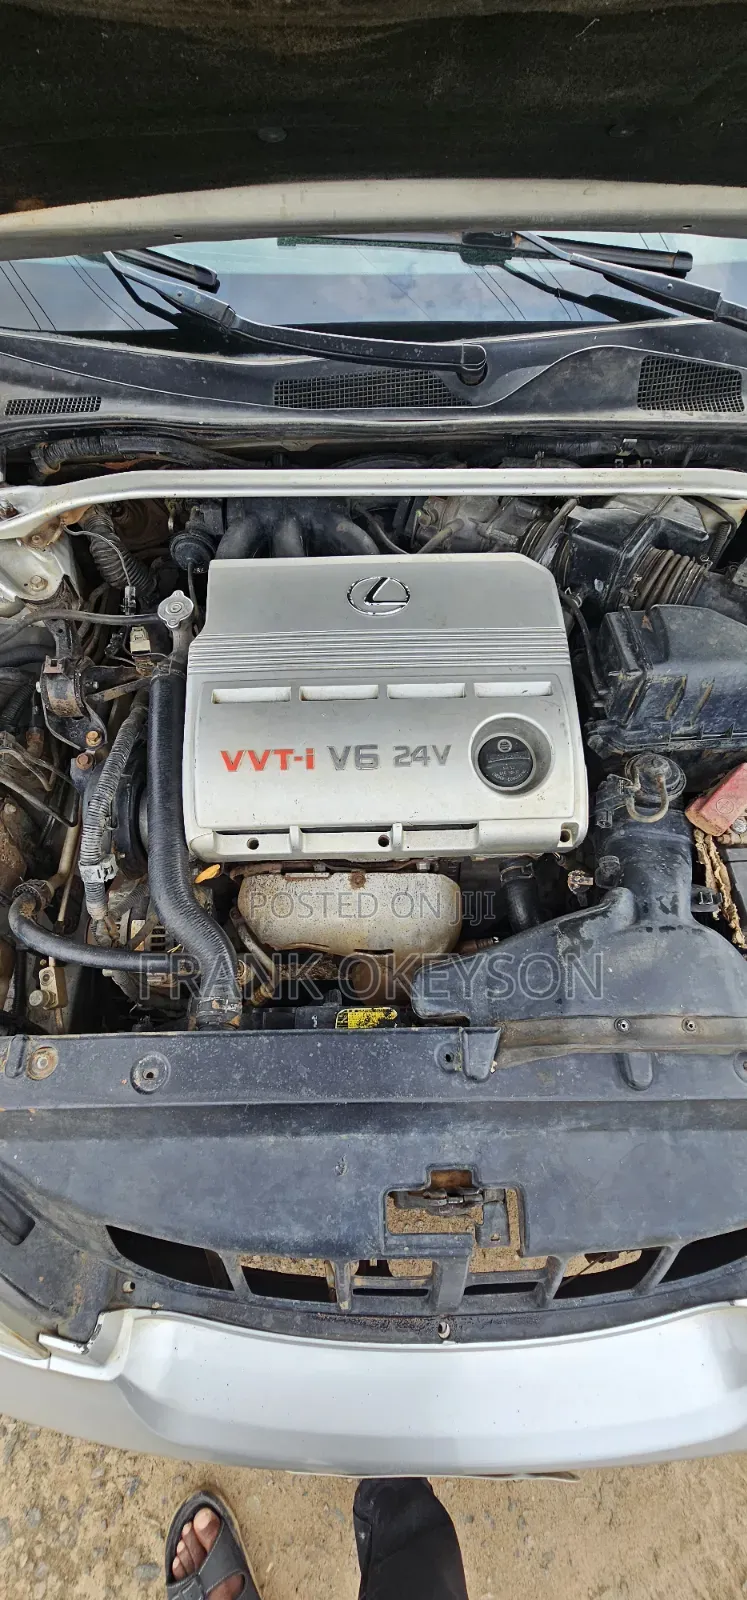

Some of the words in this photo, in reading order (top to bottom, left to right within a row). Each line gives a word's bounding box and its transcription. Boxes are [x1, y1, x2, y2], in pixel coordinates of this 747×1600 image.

[220, 748, 315, 772] VVT-i
[326, 744, 379, 771] V6
[393, 744, 452, 768] 24V
